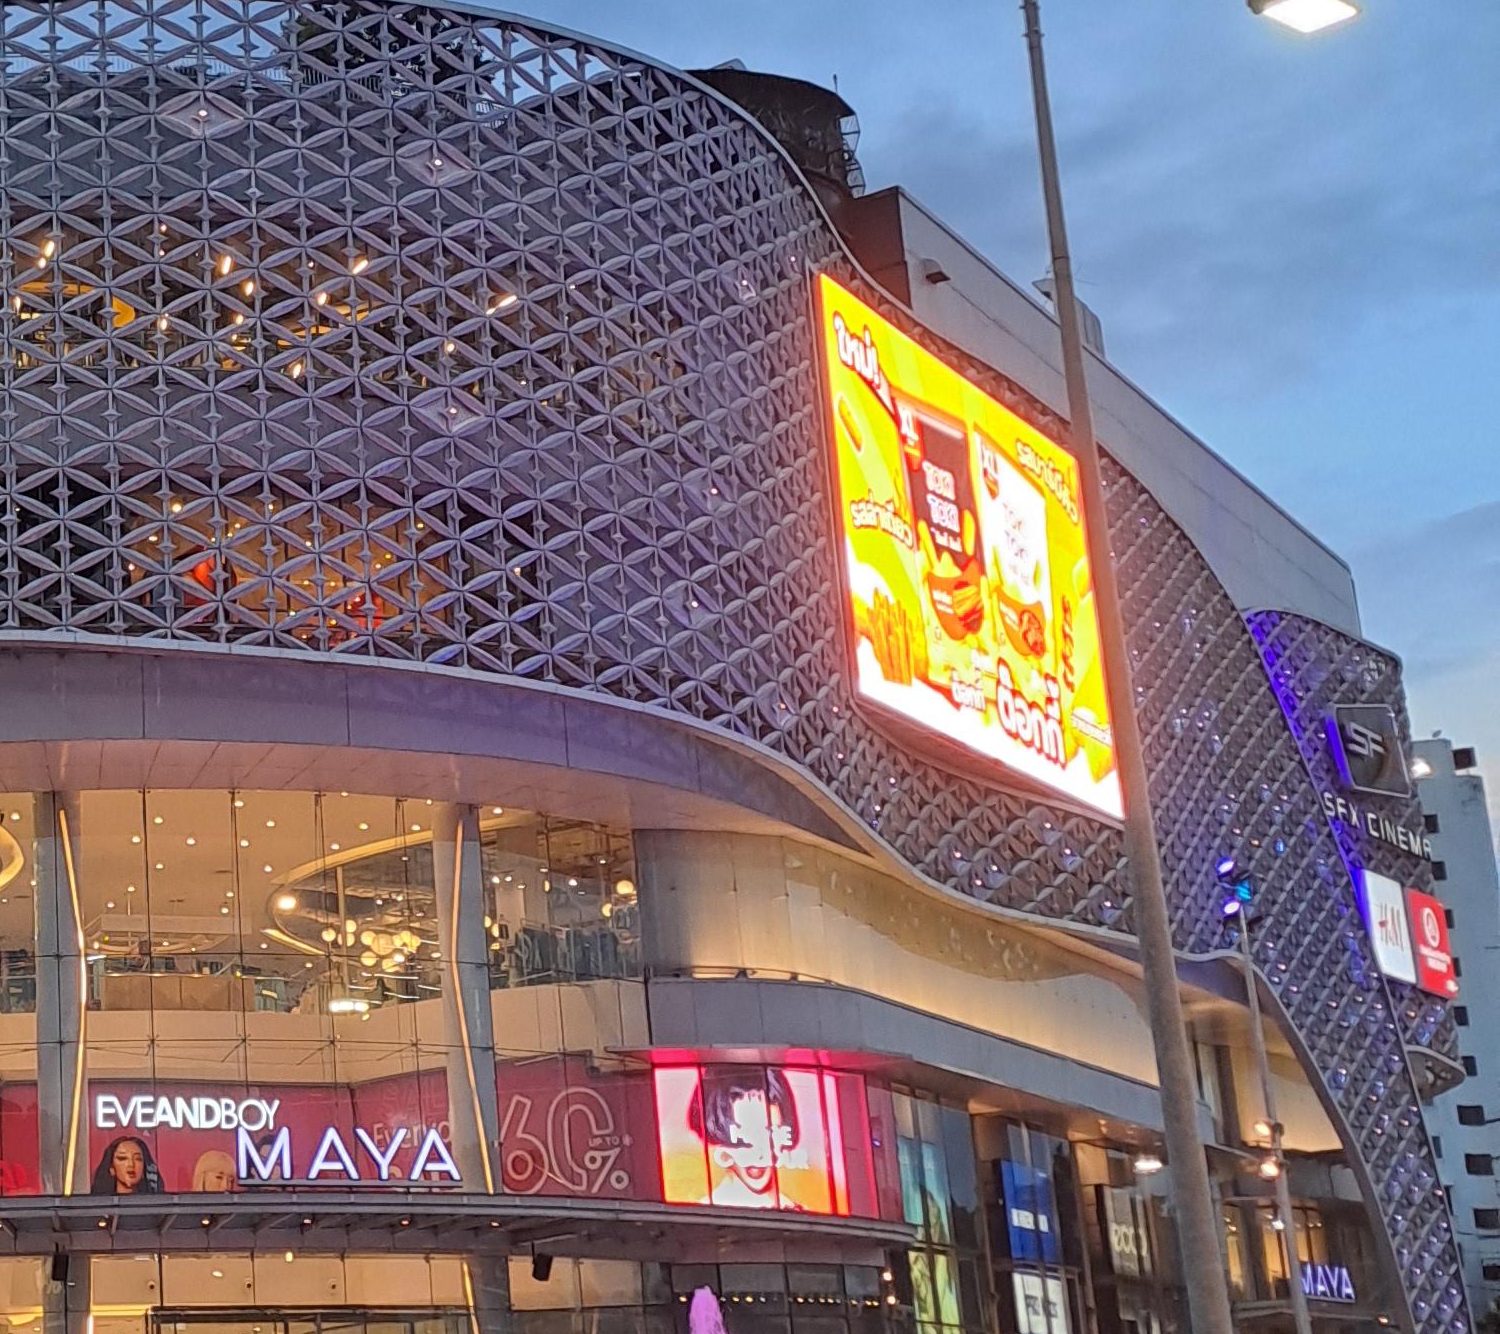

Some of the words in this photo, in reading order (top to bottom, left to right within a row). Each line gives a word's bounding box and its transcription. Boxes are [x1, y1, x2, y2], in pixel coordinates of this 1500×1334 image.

[1365, 812, 1433, 862] CINEMA
[96, 1095, 280, 1131] EVEANDBOY
[236, 1125, 462, 1181] MAYA
